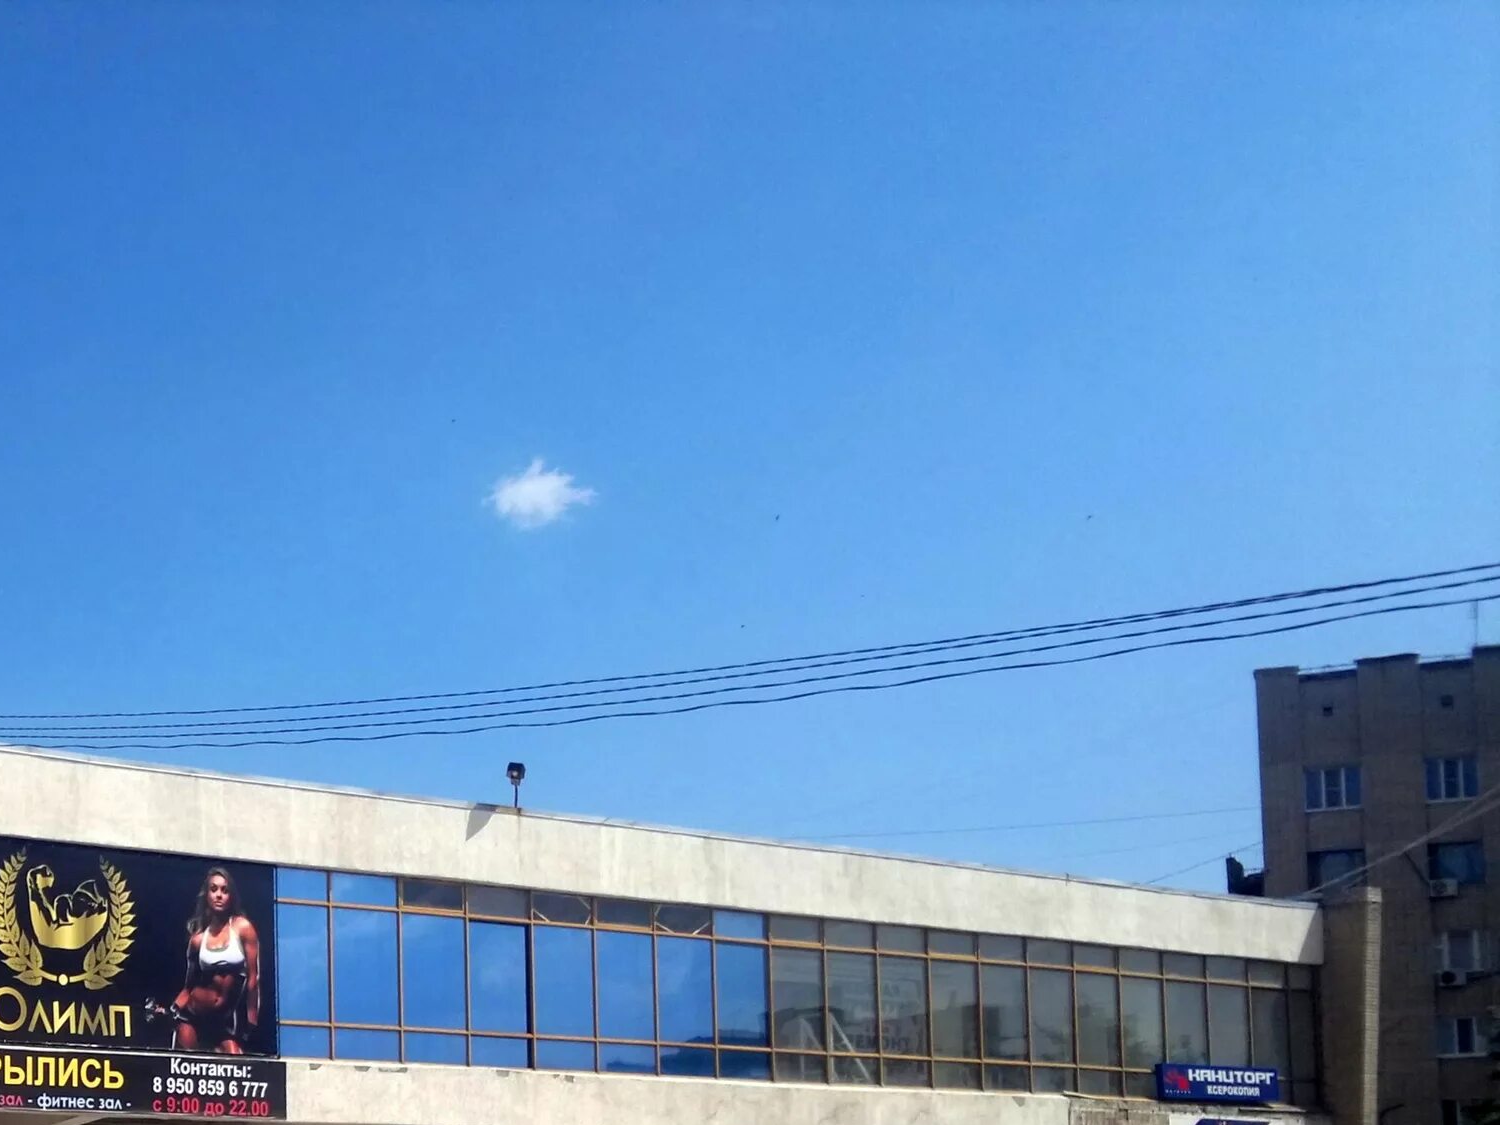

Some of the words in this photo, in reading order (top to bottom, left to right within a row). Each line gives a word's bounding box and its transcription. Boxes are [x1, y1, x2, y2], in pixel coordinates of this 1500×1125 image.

[170, 1057, 252, 1078] Контакты:
[1188, 1069, 1275, 1084] КАНЦТОРГ
[153, 1077, 162, 1093] 8
[166, 1078, 194, 1095] 950
[198, 1079, 225, 1096] 859
[228, 1081, 238, 1097] 6
[242, 1082, 268, 1098] 777
[1207, 1085, 1260, 1096] КСЕРОКОПИЯ
[0, 1094, 23, 1106] зал
[37, 1092, 94, 1111] фитнес
[99, 1098, 123, 1110] зал
[153, 1101, 162, 1112] с
[166, 1097, 200, 1114] 9:00
[203, 1103, 224, 1116] до
[229, 1101, 269, 1117] 22.00
